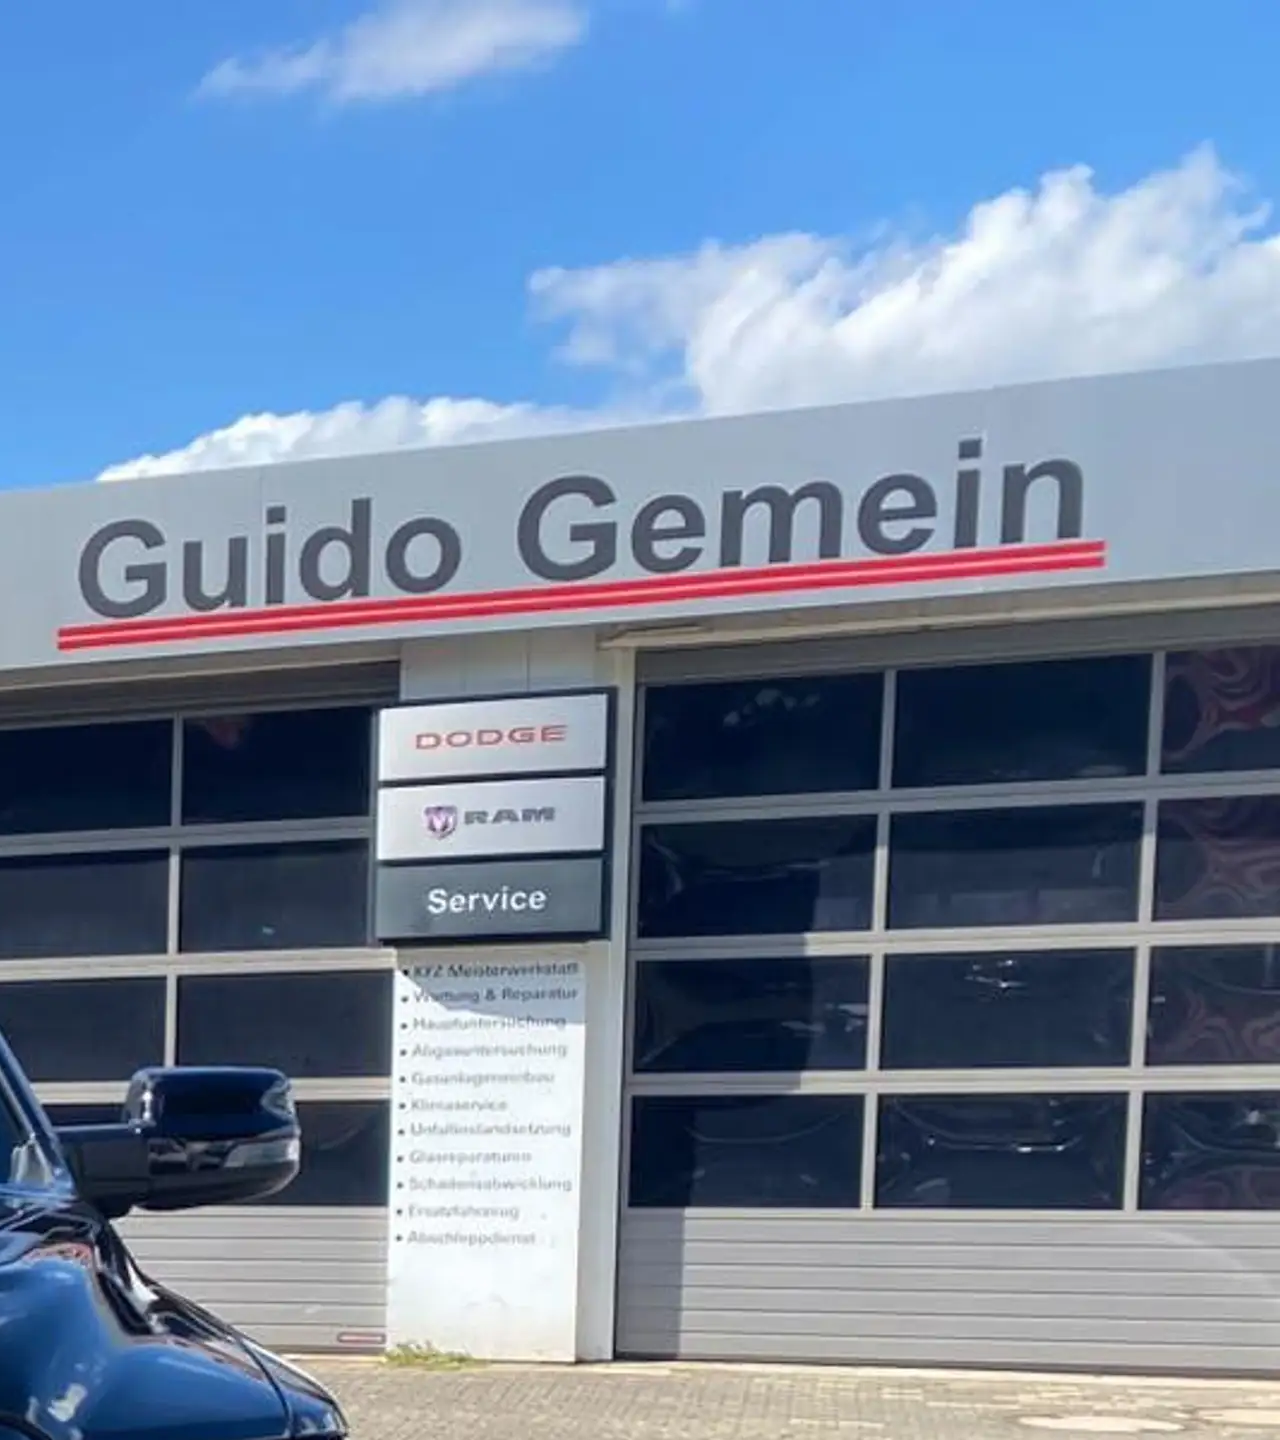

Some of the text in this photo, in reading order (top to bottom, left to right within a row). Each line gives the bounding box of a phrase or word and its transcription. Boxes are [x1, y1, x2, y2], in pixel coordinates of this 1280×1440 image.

[76, 437, 1086, 620] Guido Gemein
[416, 725, 568, 750] DODGE
[463, 806, 556, 825] RAM
[426, 886, 547, 914] Service
